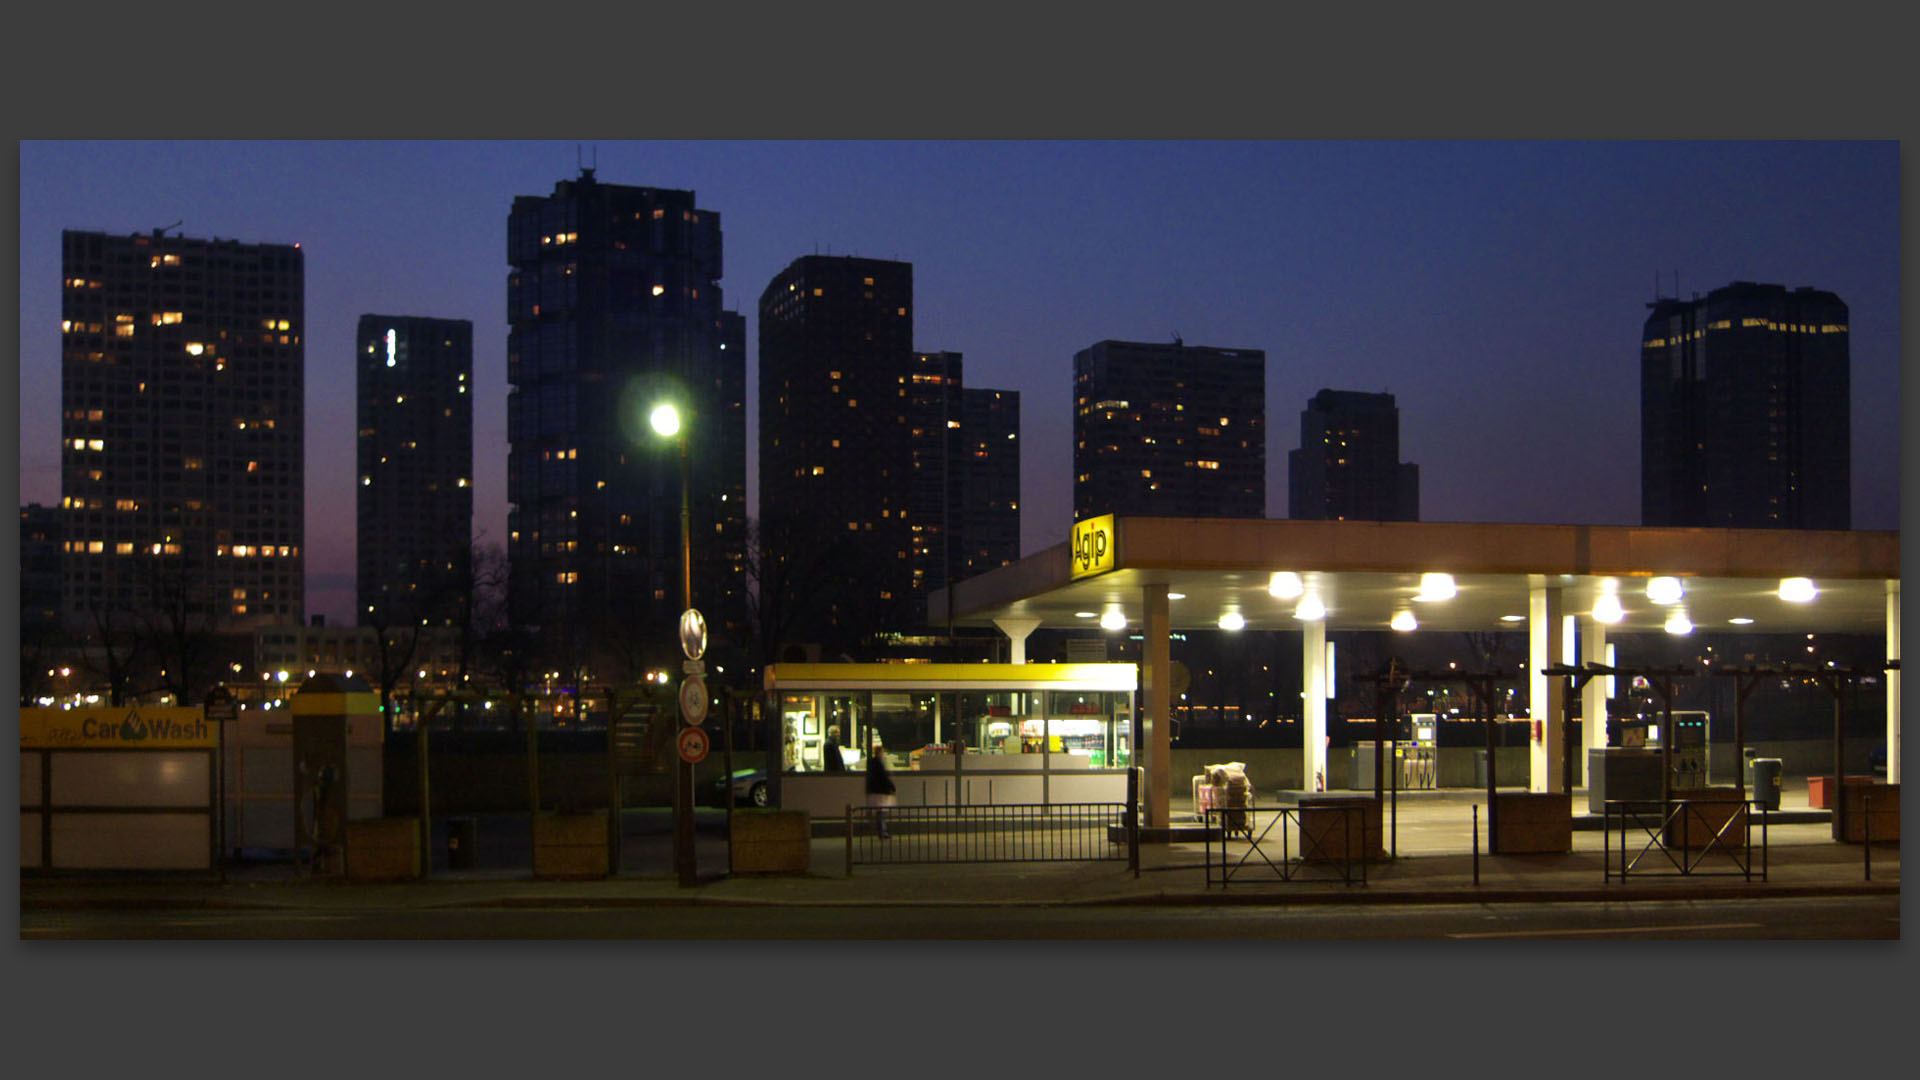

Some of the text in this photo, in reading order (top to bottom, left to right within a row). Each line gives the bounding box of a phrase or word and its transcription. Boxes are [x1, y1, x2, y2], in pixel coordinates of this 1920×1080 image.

[1074, 522, 1107, 571] Agip
[82, 718, 121, 739] Car
[149, 718, 208, 740] Wash
